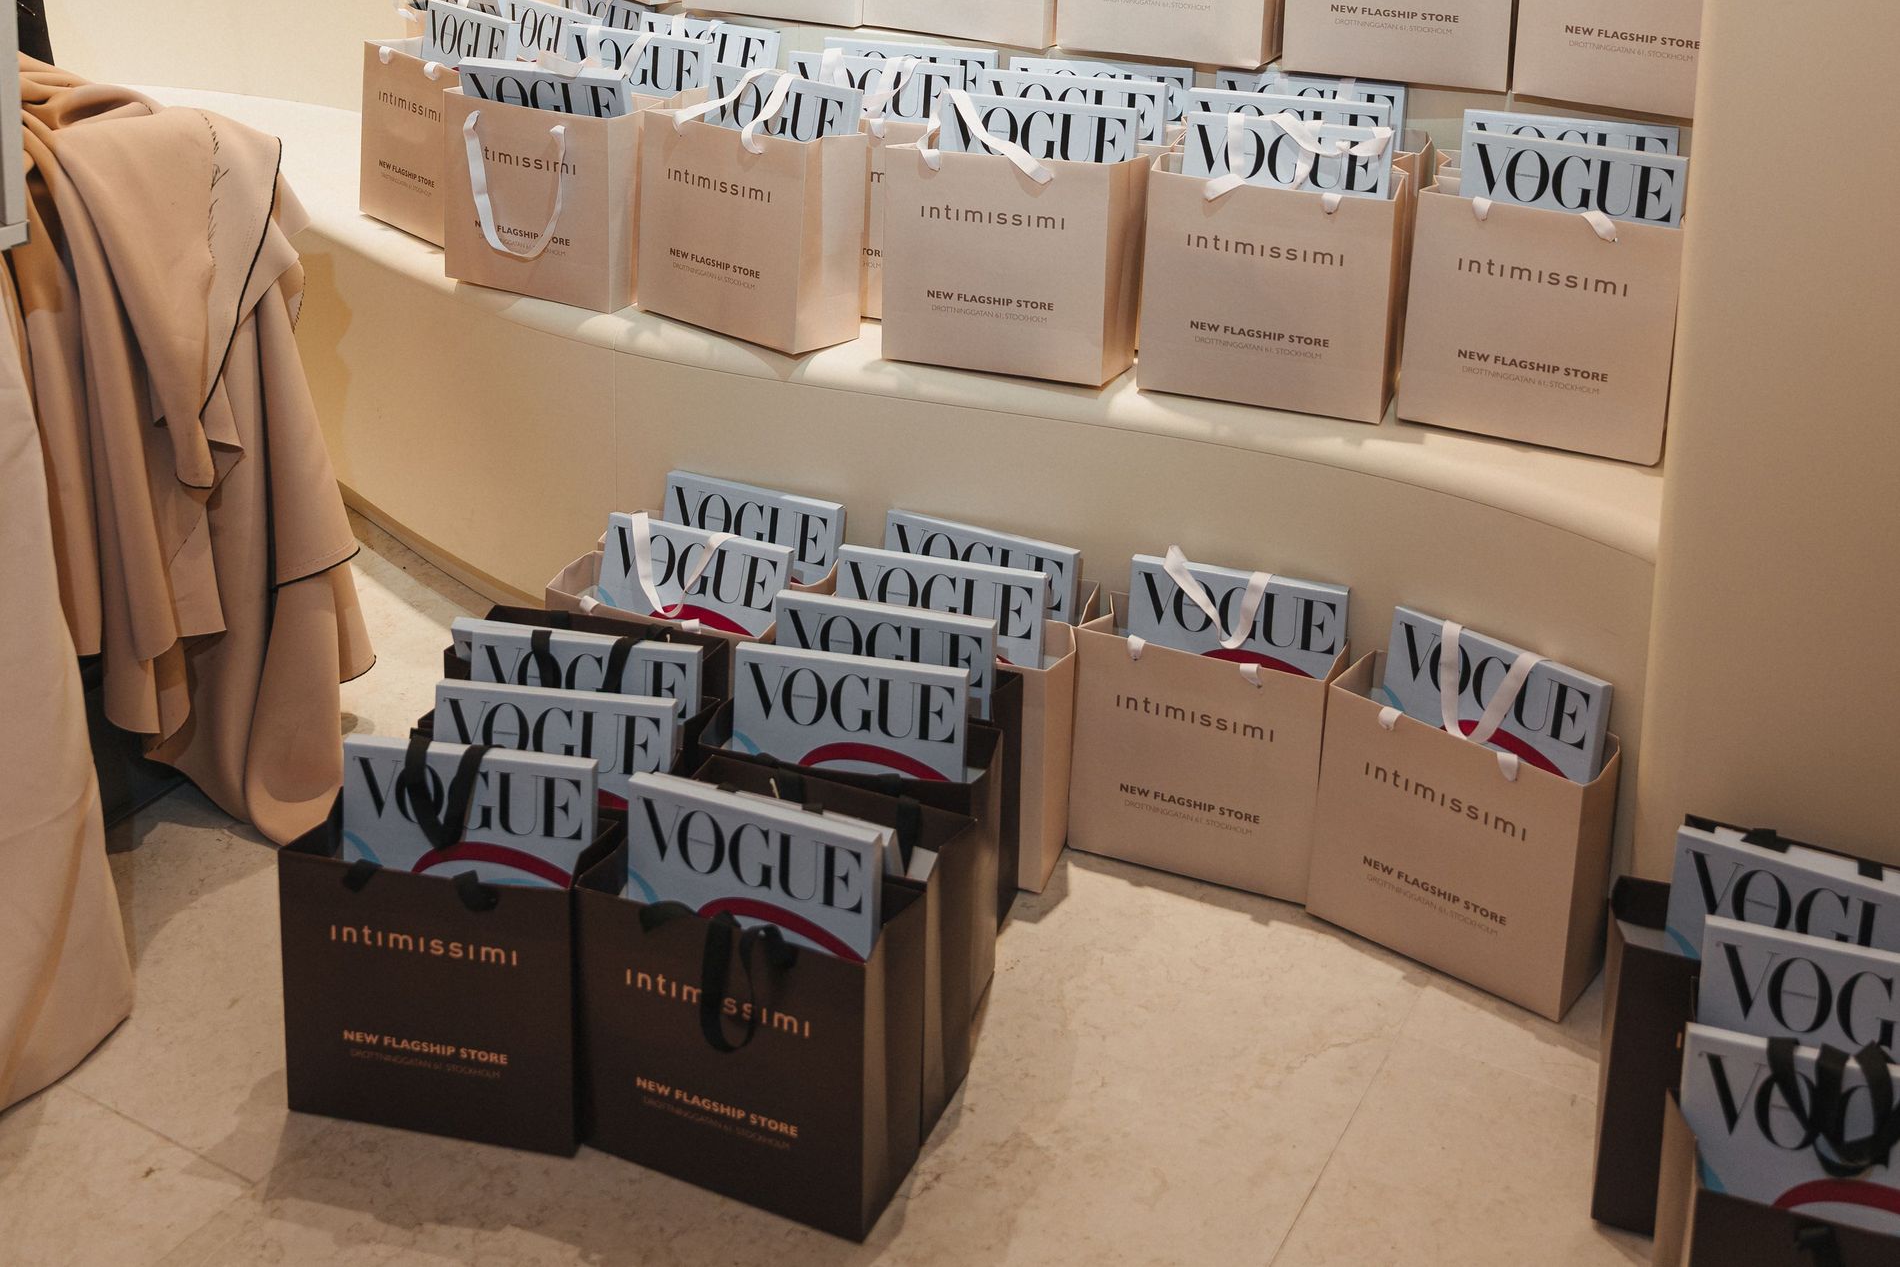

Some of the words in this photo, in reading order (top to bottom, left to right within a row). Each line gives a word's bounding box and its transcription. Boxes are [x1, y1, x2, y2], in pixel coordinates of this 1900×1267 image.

[430, 9, 504, 59] VOGUE
[1331, 4, 1358, 14] NEW
[1361, 7, 1418, 19] FLAGSHIP
[1421, 12, 1459, 23] STORE
[1565, 25, 1594, 36] NEW
[1597, 29, 1657, 43] FLAGSHIP
[1661, 36, 1700, 50] STORE
[379, 91, 440, 122] intimissimi
[466, 72, 617, 118] VOGUE
[949, 103, 1126, 163] VOGUE
[379, 159, 391, 170] NEW
[392, 165, 417, 180] FLAGSHIP
[418, 176, 435, 188] STORE
[484, 146, 576, 175] timissimi
[1193, 124, 1379, 193] VOGUE
[1472, 142, 1675, 222] VOGUE
[667, 168, 771, 203] intimissimi
[497, 225, 538, 239] FLAGSHIP
[921, 204, 1065, 230] intimissimi
[670, 248, 688, 260] NEW
[691, 253, 731, 271] FLAGSHIP
[733, 265, 760, 279] STORE
[1187, 234, 1344, 266] intimissimi
[927, 290, 954, 300] NEW
[957, 294, 1013, 307] FLAGSHIP
[1016, 300, 1054, 311] STORE
[1458, 258, 1628, 297] intimissimi
[1190, 320, 1220, 332] NEW
[1224, 325, 1285, 341] FLAGSHIP
[1289, 334, 1329, 348] STORE
[1457, 349, 1490, 363] NEW
[1494, 355, 1560, 374] FLAGSHIP
[1564, 367, 1609, 382] STORE
[671, 485, 828, 568] VOGUE
[614, 525, 778, 613] VOGUE
[845, 560, 1033, 640] VOGUE
[1139, 571, 1336, 656] VOGUE
[784, 607, 982, 688] VOGUE
[480, 644, 686, 719] VOGE
[744, 661, 955, 744] VOGUE
[1400, 622, 1591, 750] VOGUE
[443, 697, 660, 775] VOGUE
[1116, 695, 1274, 742] intimissimi
[1120, 783, 1150, 797] NEW
[1154, 791, 1215, 813] FLAGSHIP
[1219, 807, 1260, 824] STORE
[1365, 762, 1526, 841] intimissimi
[637, 795, 862, 914] VOGUE
[1363, 855, 1393, 875] NEW
[1397, 871, 1460, 904] FLAGSHIP
[1464, 900, 1507, 926] STORE
[331, 925, 517, 966] intimissimi
[626, 969, 810, 1038] intimssimi
[343, 1030, 379, 1046] NEW
[383, 1036, 456, 1056] FLAGSHIP
[460, 1047, 508, 1065] STORE
[636, 1076, 671, 1097] NEW
[675, 1089, 746, 1120] FLAGSHIP
[750, 1113, 798, 1138] STORE
